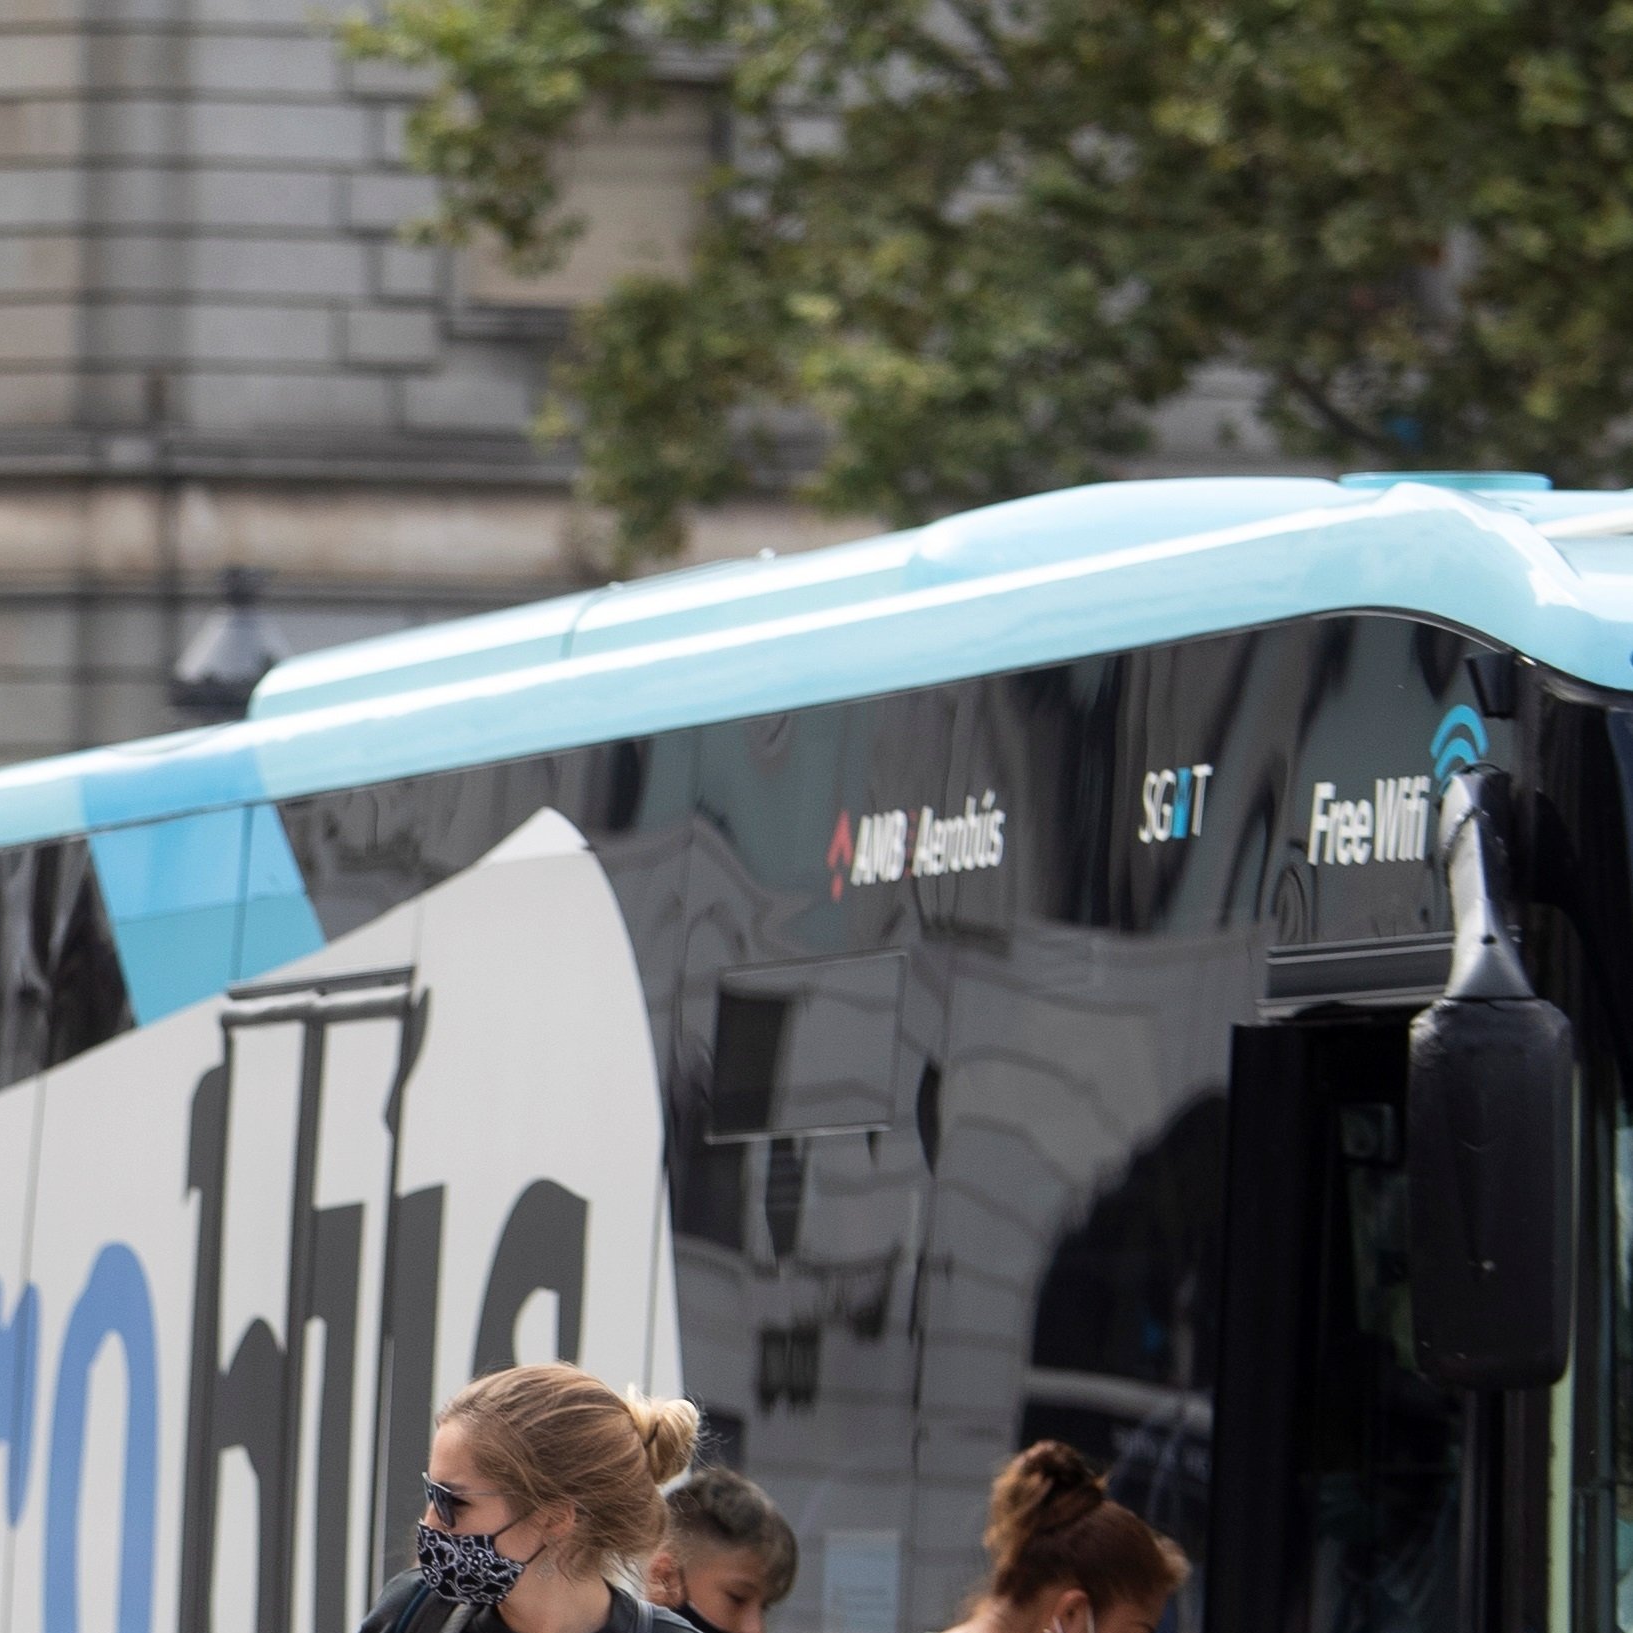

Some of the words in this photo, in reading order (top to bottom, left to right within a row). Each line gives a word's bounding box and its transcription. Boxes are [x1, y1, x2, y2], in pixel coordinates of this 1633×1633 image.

[850, 809, 908, 886] AMB
[912, 787, 1006, 878] Aerobús
[1307, 781, 1373, 866] Free
[1374, 775, 1431, 863] Wifi
